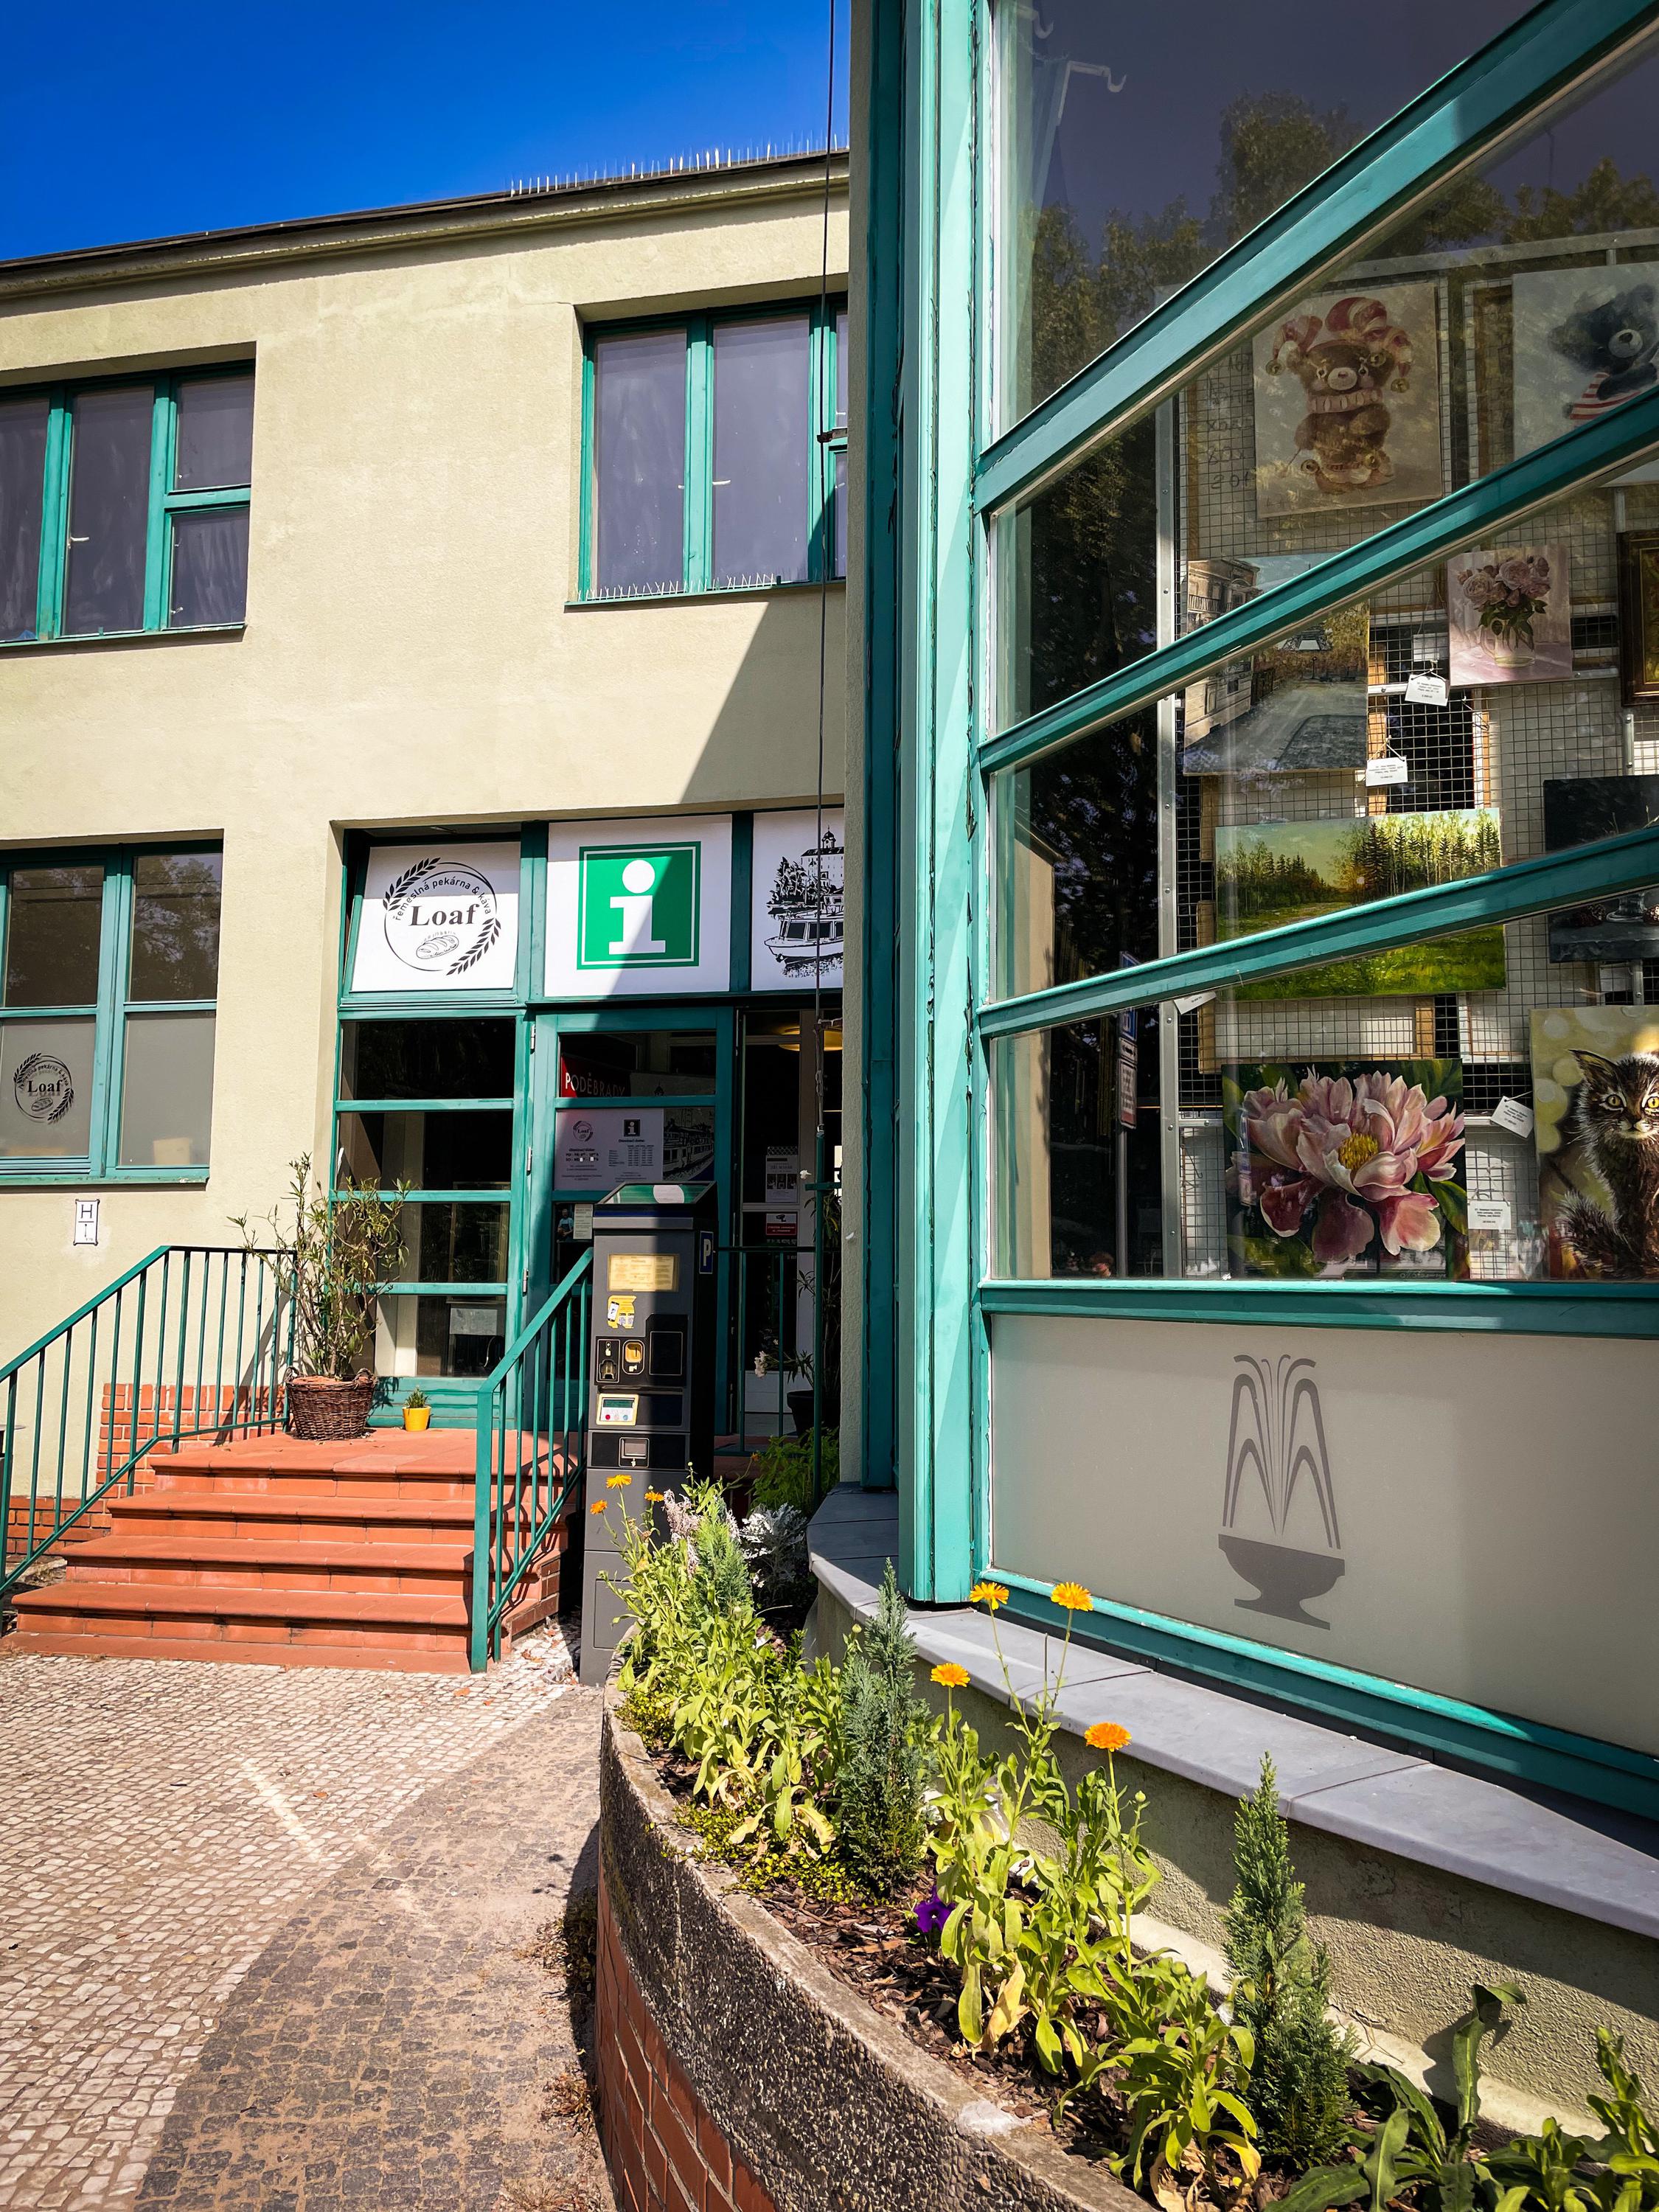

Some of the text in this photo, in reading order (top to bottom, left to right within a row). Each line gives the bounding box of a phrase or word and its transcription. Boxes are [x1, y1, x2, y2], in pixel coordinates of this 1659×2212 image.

[392, 876, 491, 921] řemeslná pekárna & káva
[408, 903, 479, 927] Loaf
[27, 1079, 63, 1093] Loaf
[80, 1204, 93, 1219] H
[703, 1238, 712, 1267] P
